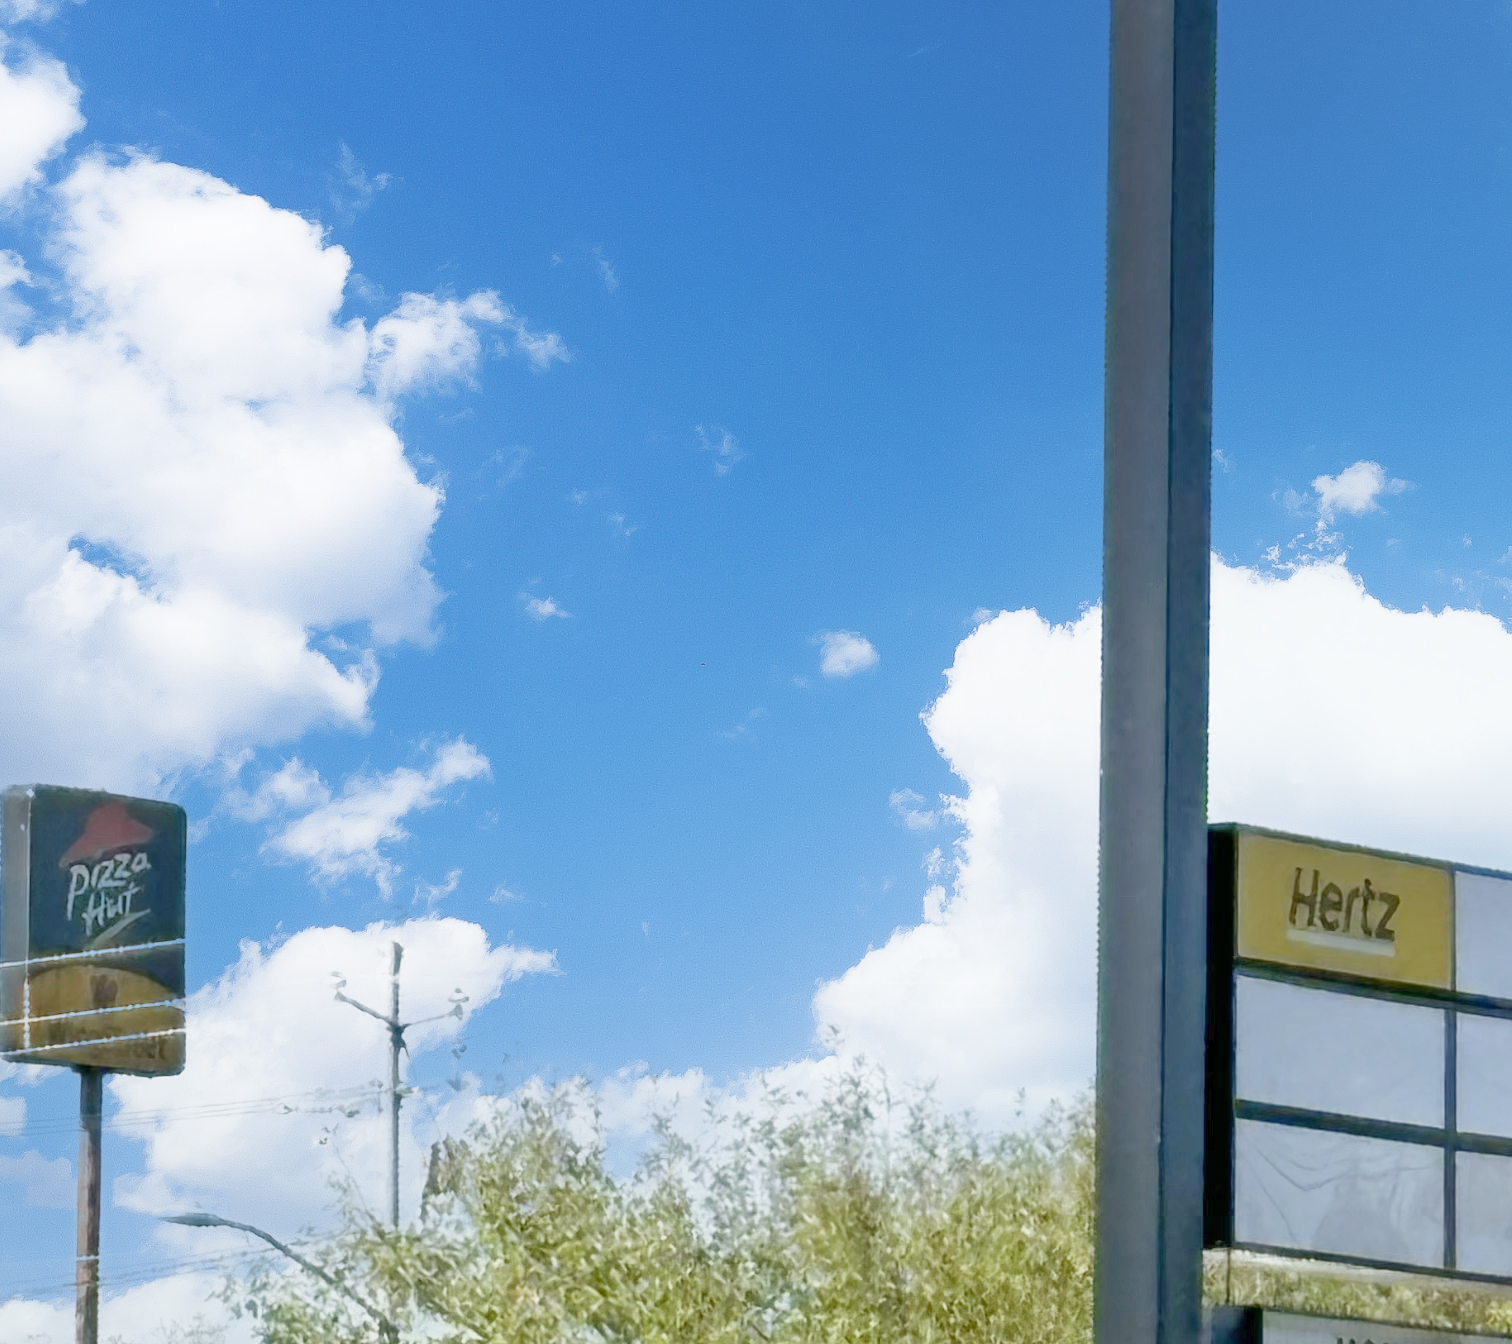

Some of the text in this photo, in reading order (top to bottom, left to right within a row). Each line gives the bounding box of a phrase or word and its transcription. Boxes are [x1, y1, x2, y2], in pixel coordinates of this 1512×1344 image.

[67, 852, 152, 922] Pizza
[81, 881, 142, 937] Hut
[1289, 867, 1401, 942] Hertz
